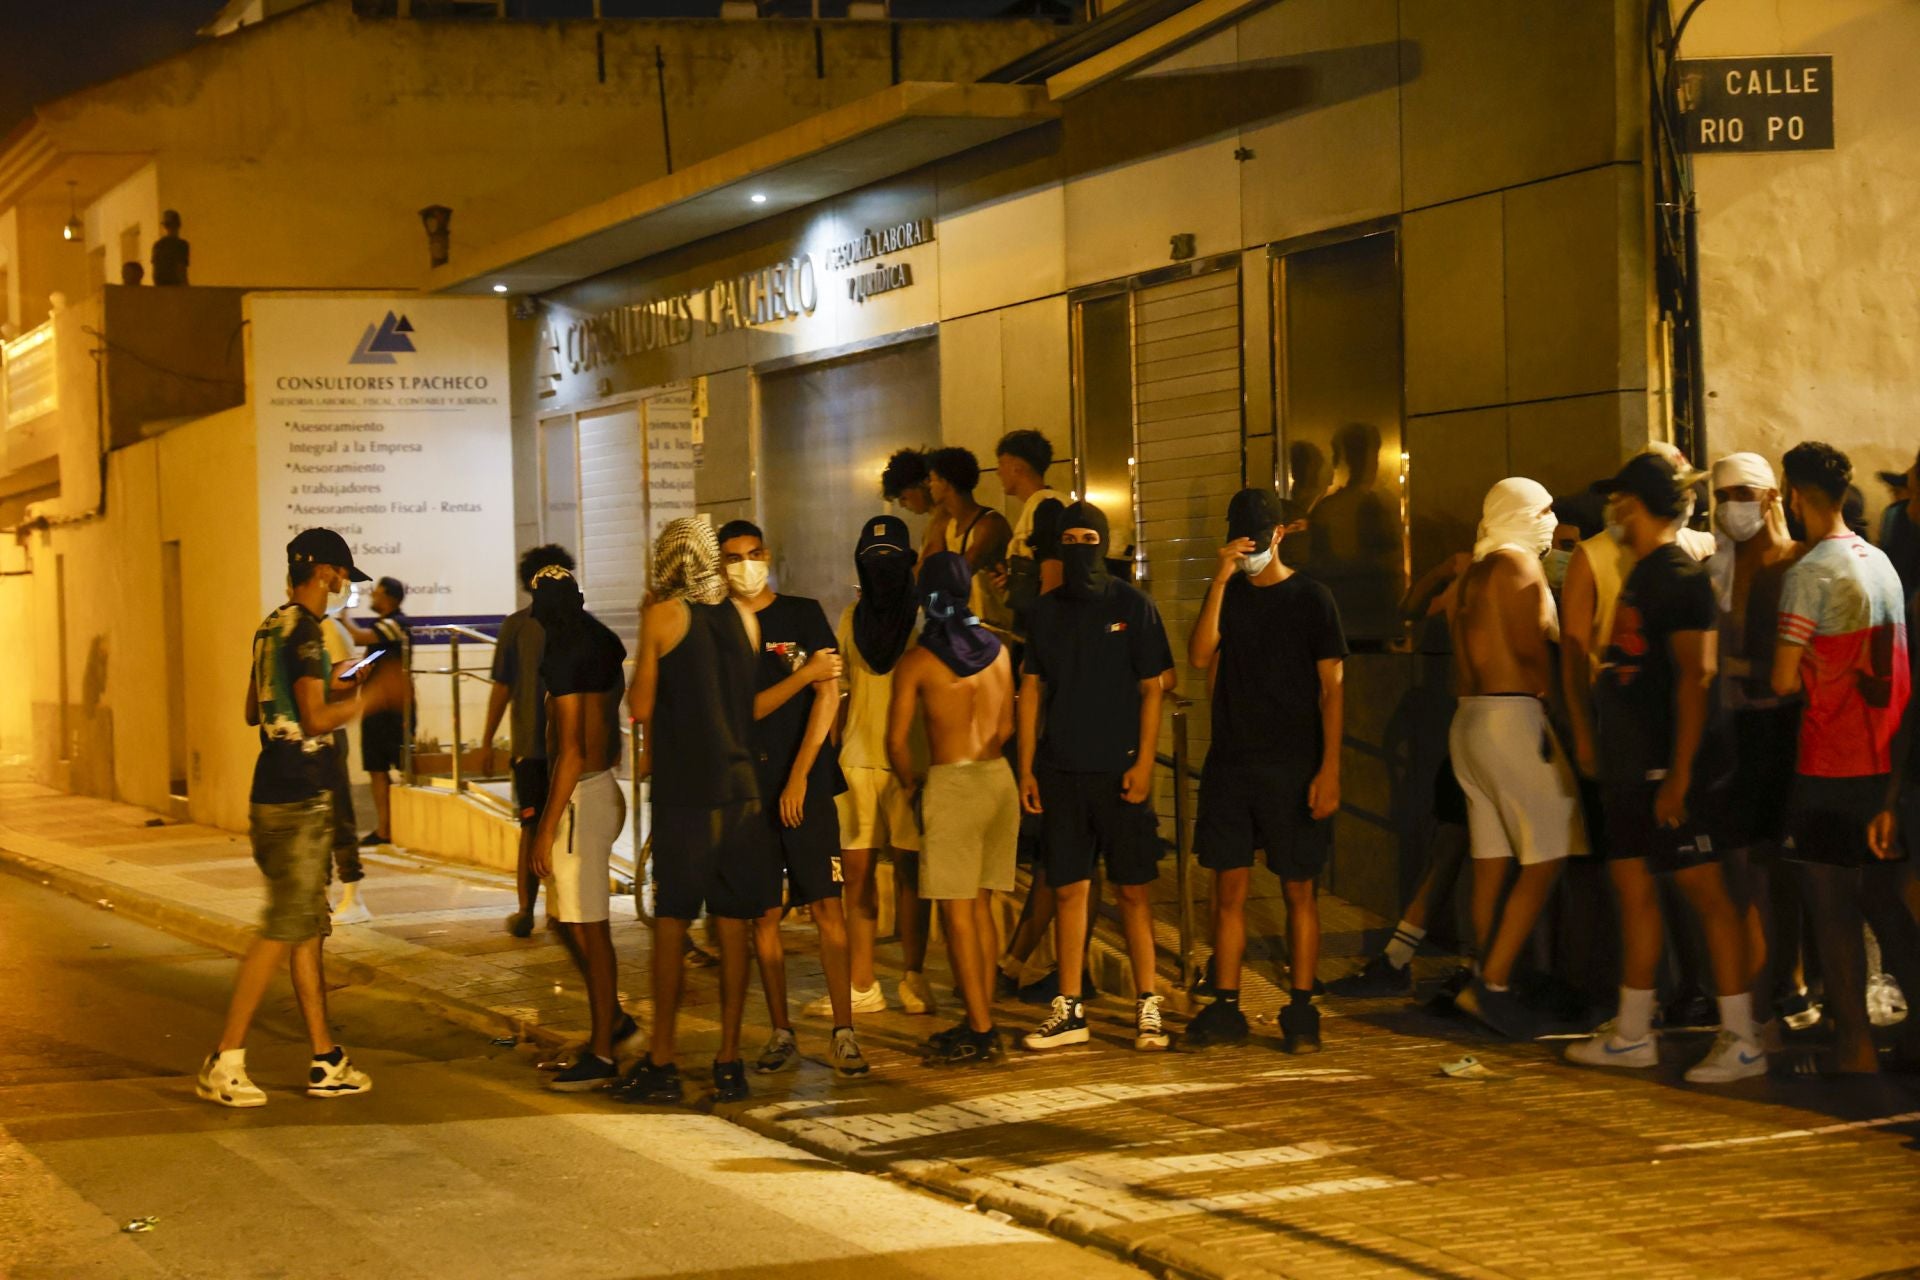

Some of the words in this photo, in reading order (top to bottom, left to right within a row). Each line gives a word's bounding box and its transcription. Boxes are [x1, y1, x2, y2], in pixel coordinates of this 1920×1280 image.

[1725, 68, 1819, 96] CALLE
[1700, 117, 1744, 144] RIO
[1767, 115, 1804, 142] PO
[275, 376, 394, 391] CONSULTORES
[289, 440, 338, 457] Integral
[342, 444, 350, 453] a
[353, 440, 366, 453] la
[370, 441, 422, 455] Empresa
[290, 486, 298, 494] a
[302, 482, 381, 496] trabajadores
[391, 501, 427, 513] Fiscal
[441, 501, 482, 513] Rentas
[362, 541, 402, 556] Social
[404, 582, 452, 595] borales
